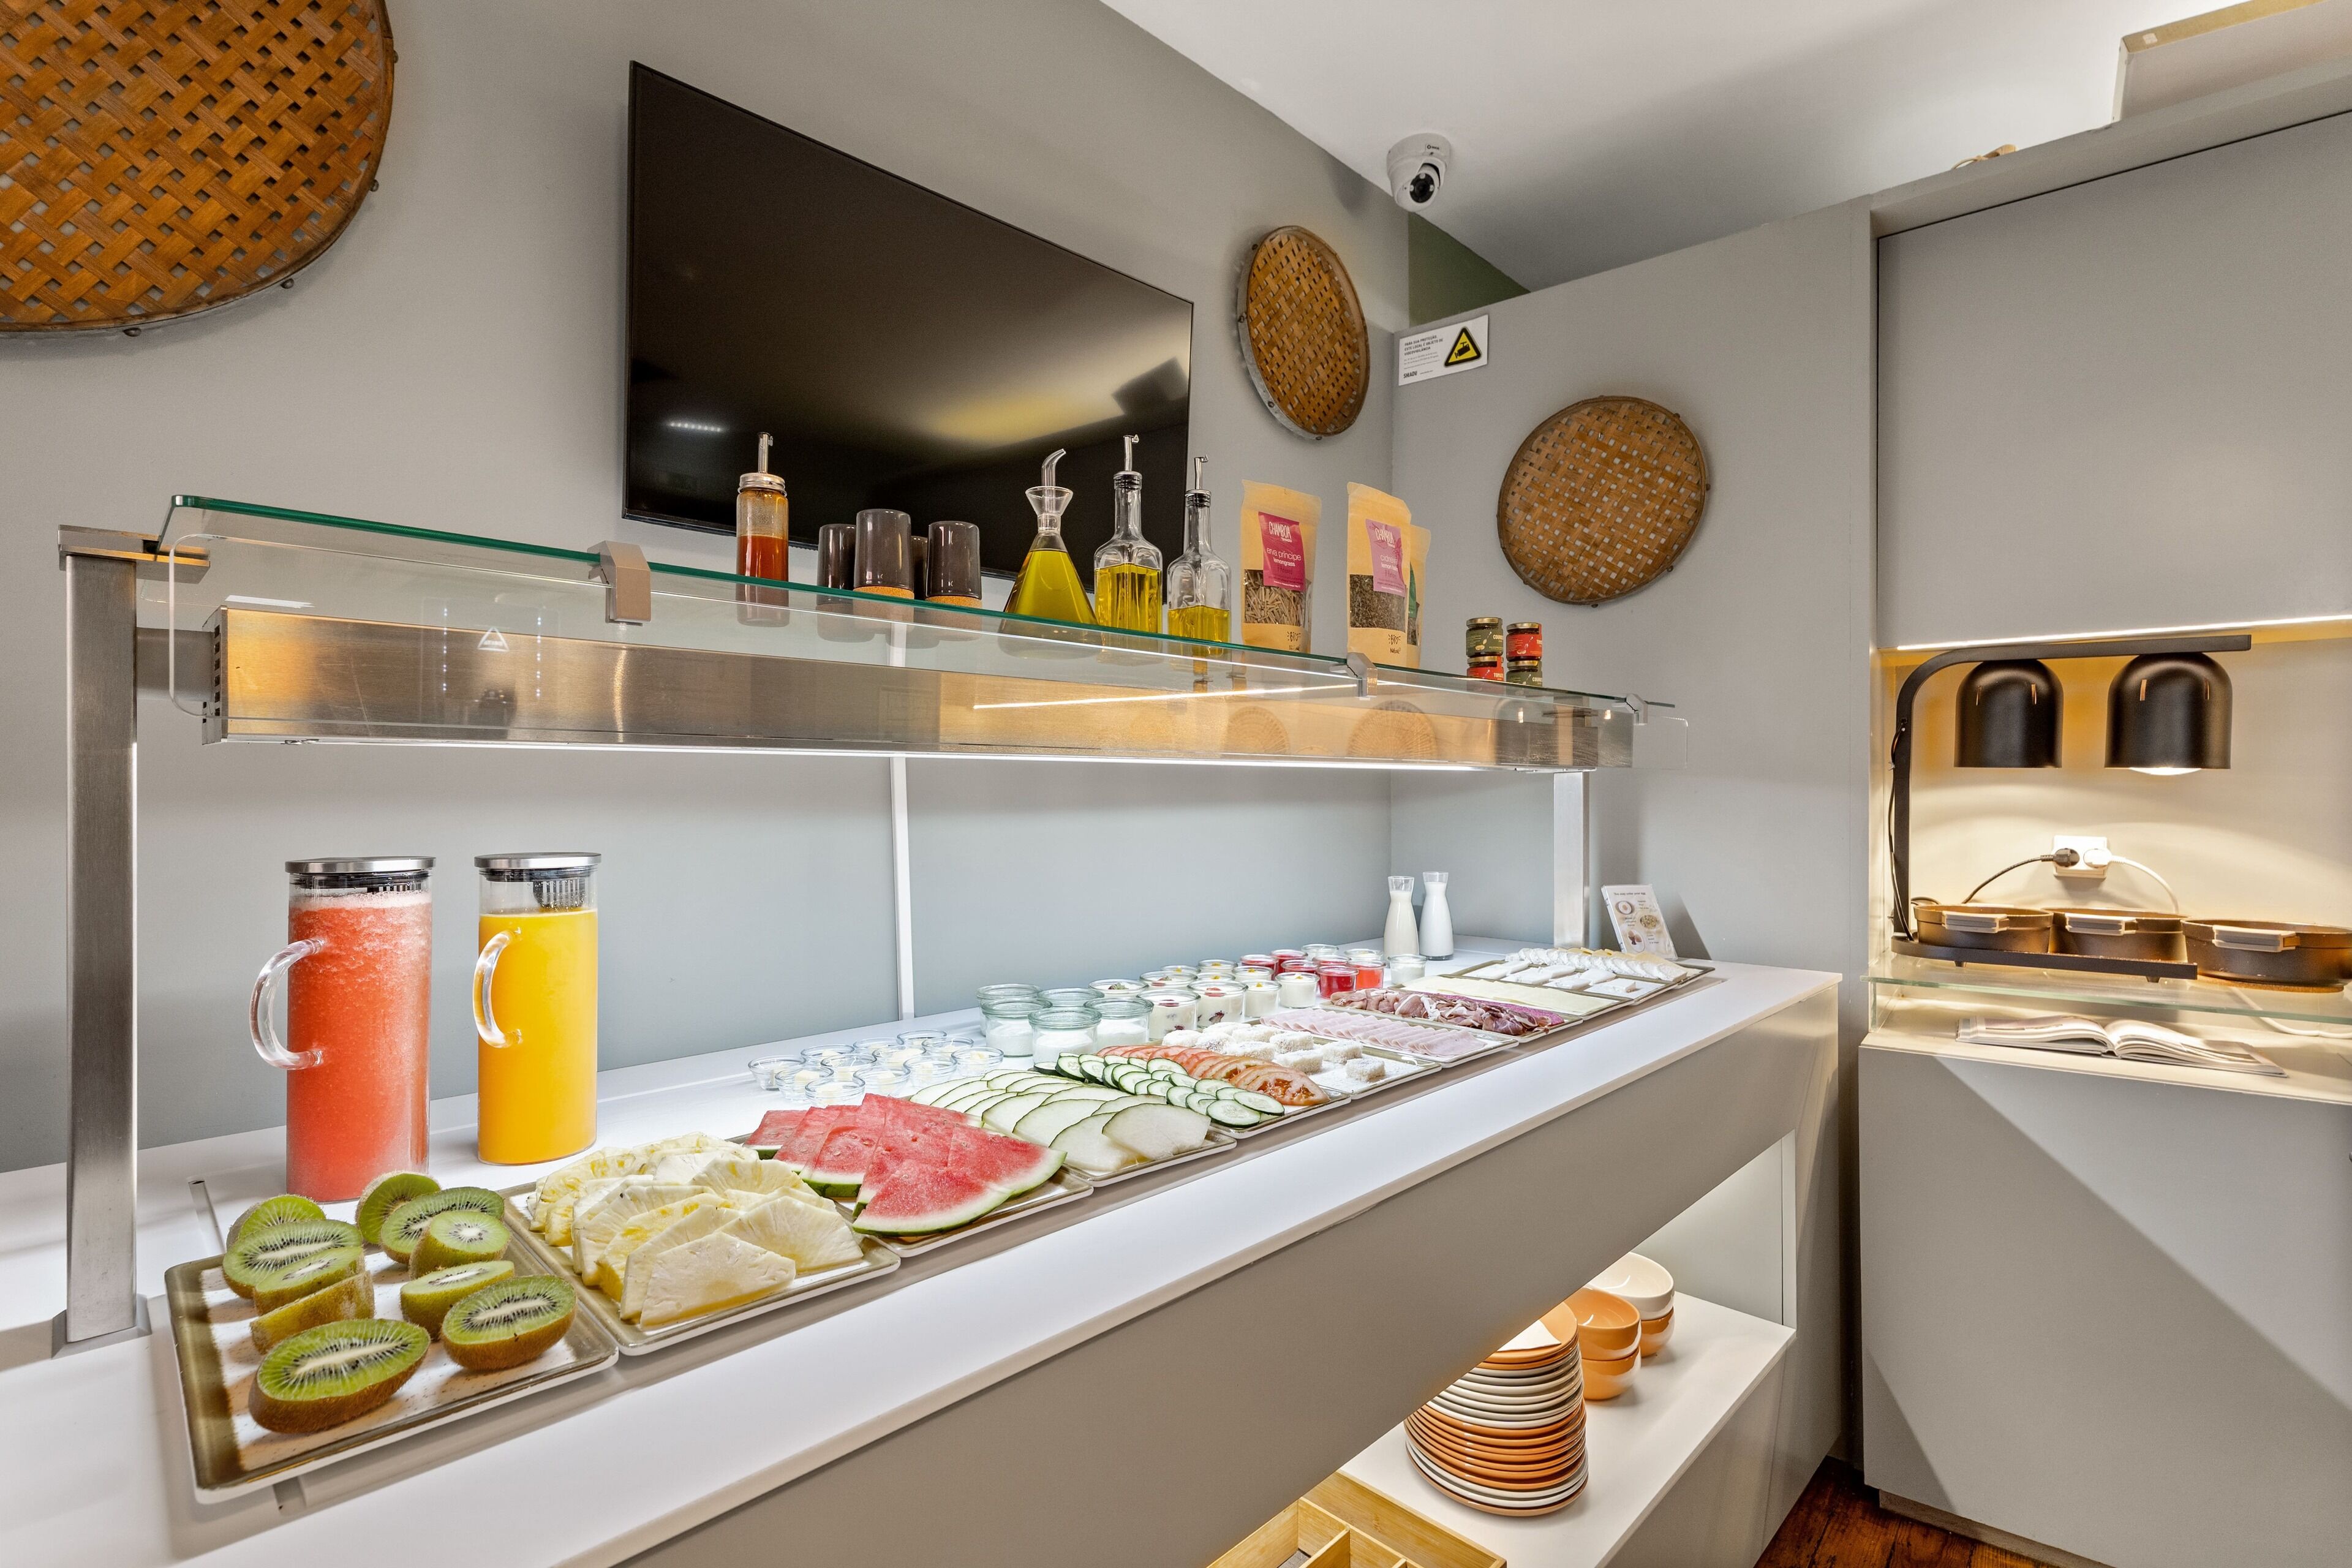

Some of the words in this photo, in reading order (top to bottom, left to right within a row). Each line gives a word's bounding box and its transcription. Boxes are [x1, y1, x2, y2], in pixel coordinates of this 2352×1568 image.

[1268, 521, 1292, 539] CHAMBOA
[1375, 528, 1395, 545] CHAMBOA
[1266, 548, 1278, 556] erva
[1273, 557, 1295, 567] lemongrass
